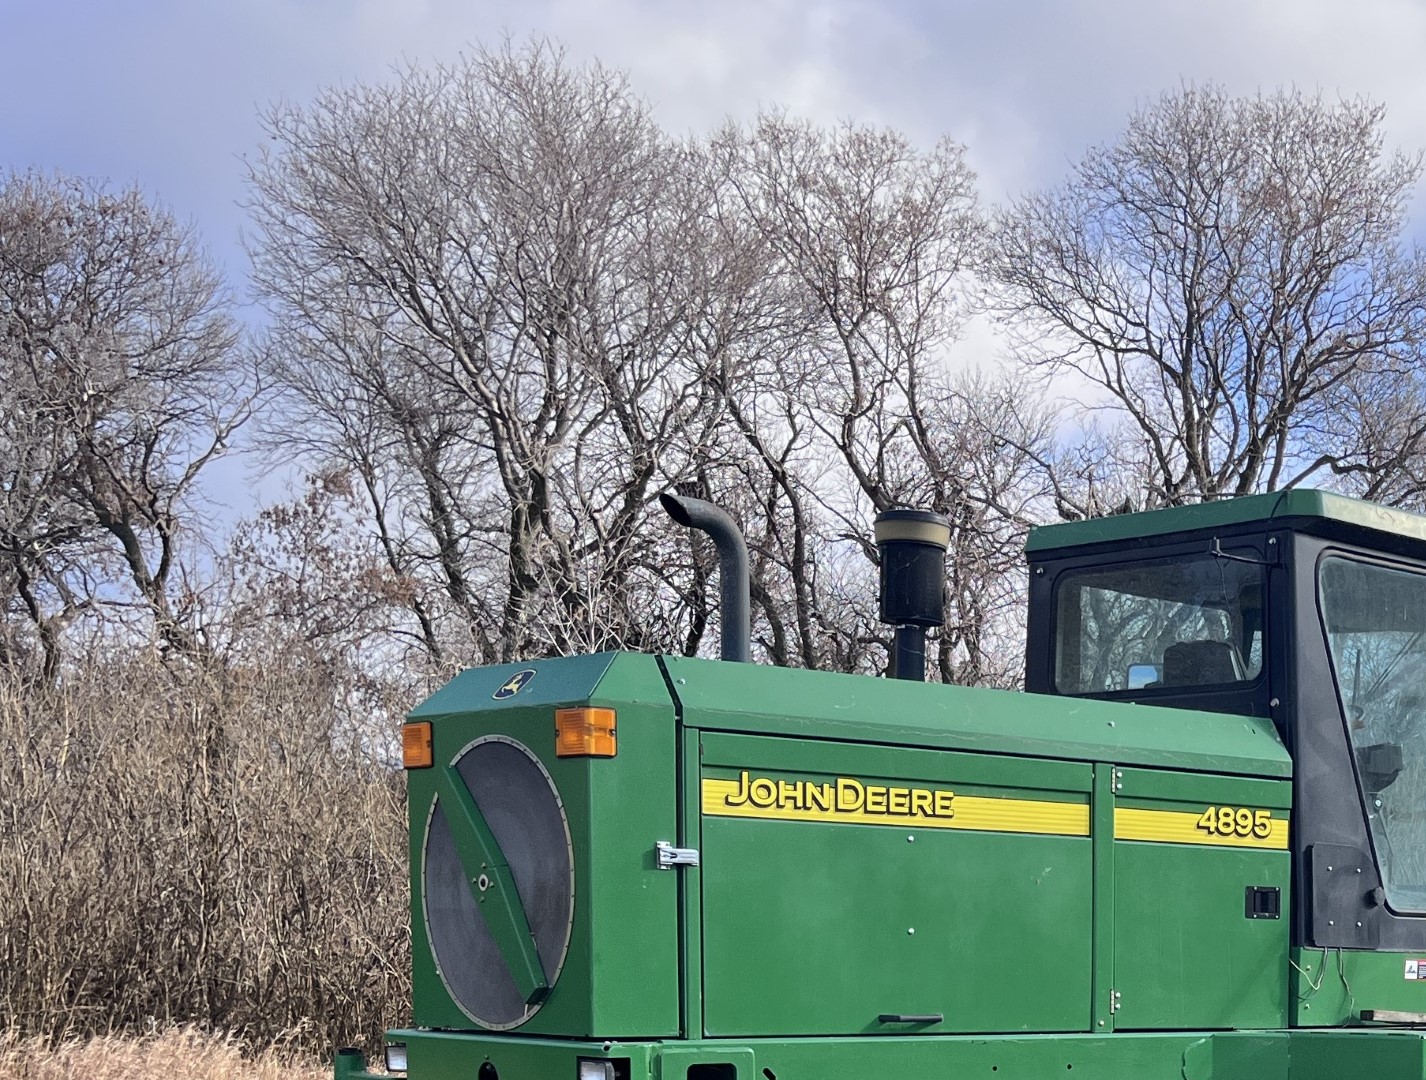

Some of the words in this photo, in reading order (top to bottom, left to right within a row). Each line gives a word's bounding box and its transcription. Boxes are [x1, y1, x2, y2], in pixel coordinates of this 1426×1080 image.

[725, 770, 831, 812] JOHN
[834, 777, 955, 818] DEERE
[1197, 806, 1272, 839] 4895
